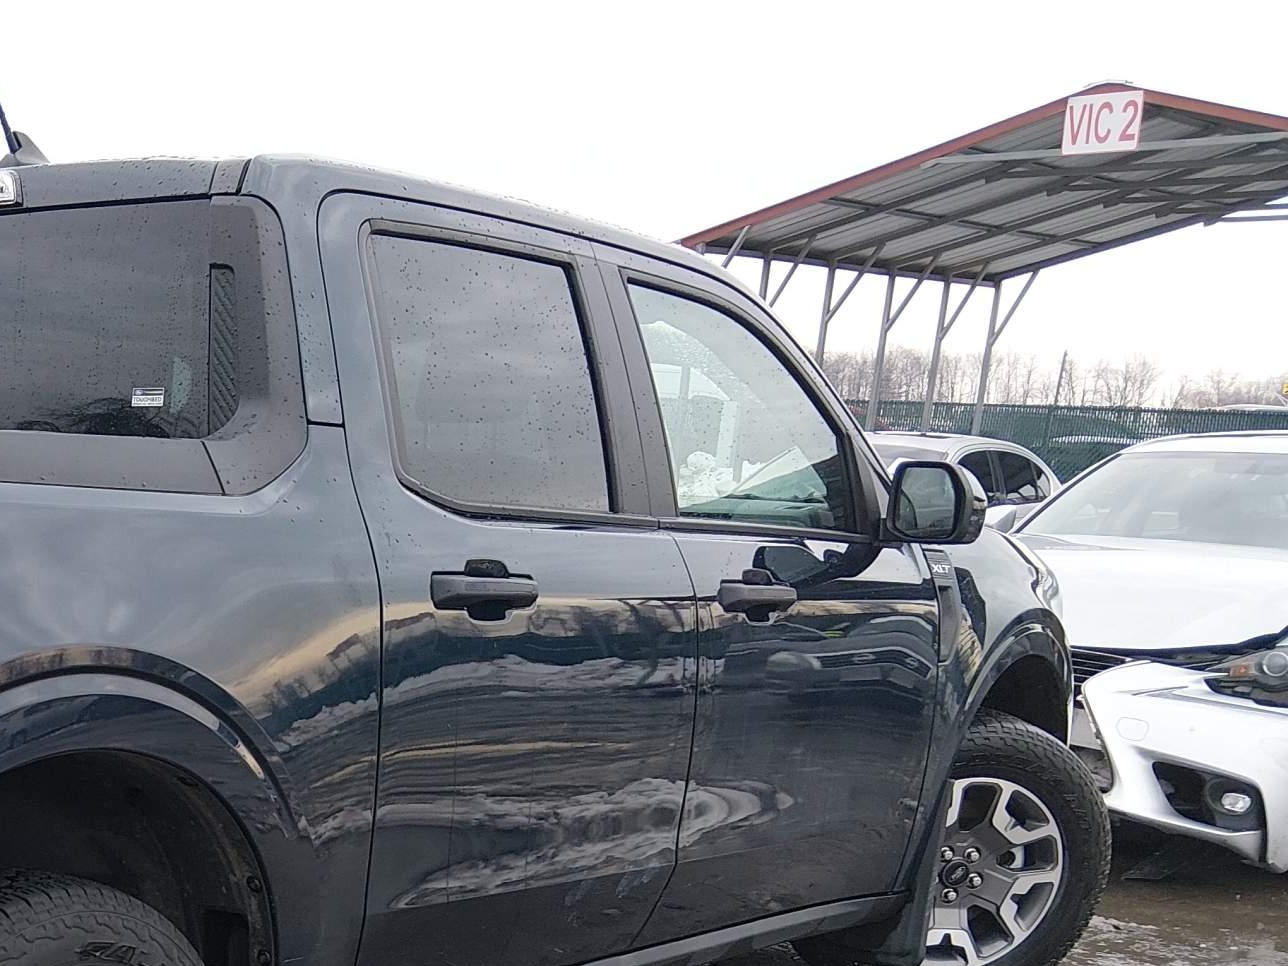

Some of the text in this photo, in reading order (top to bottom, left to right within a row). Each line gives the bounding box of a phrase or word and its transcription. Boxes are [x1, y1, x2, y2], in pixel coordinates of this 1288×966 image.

[1069, 99, 1139, 145] VIC 2
[931, 563, 951, 574] XLT
